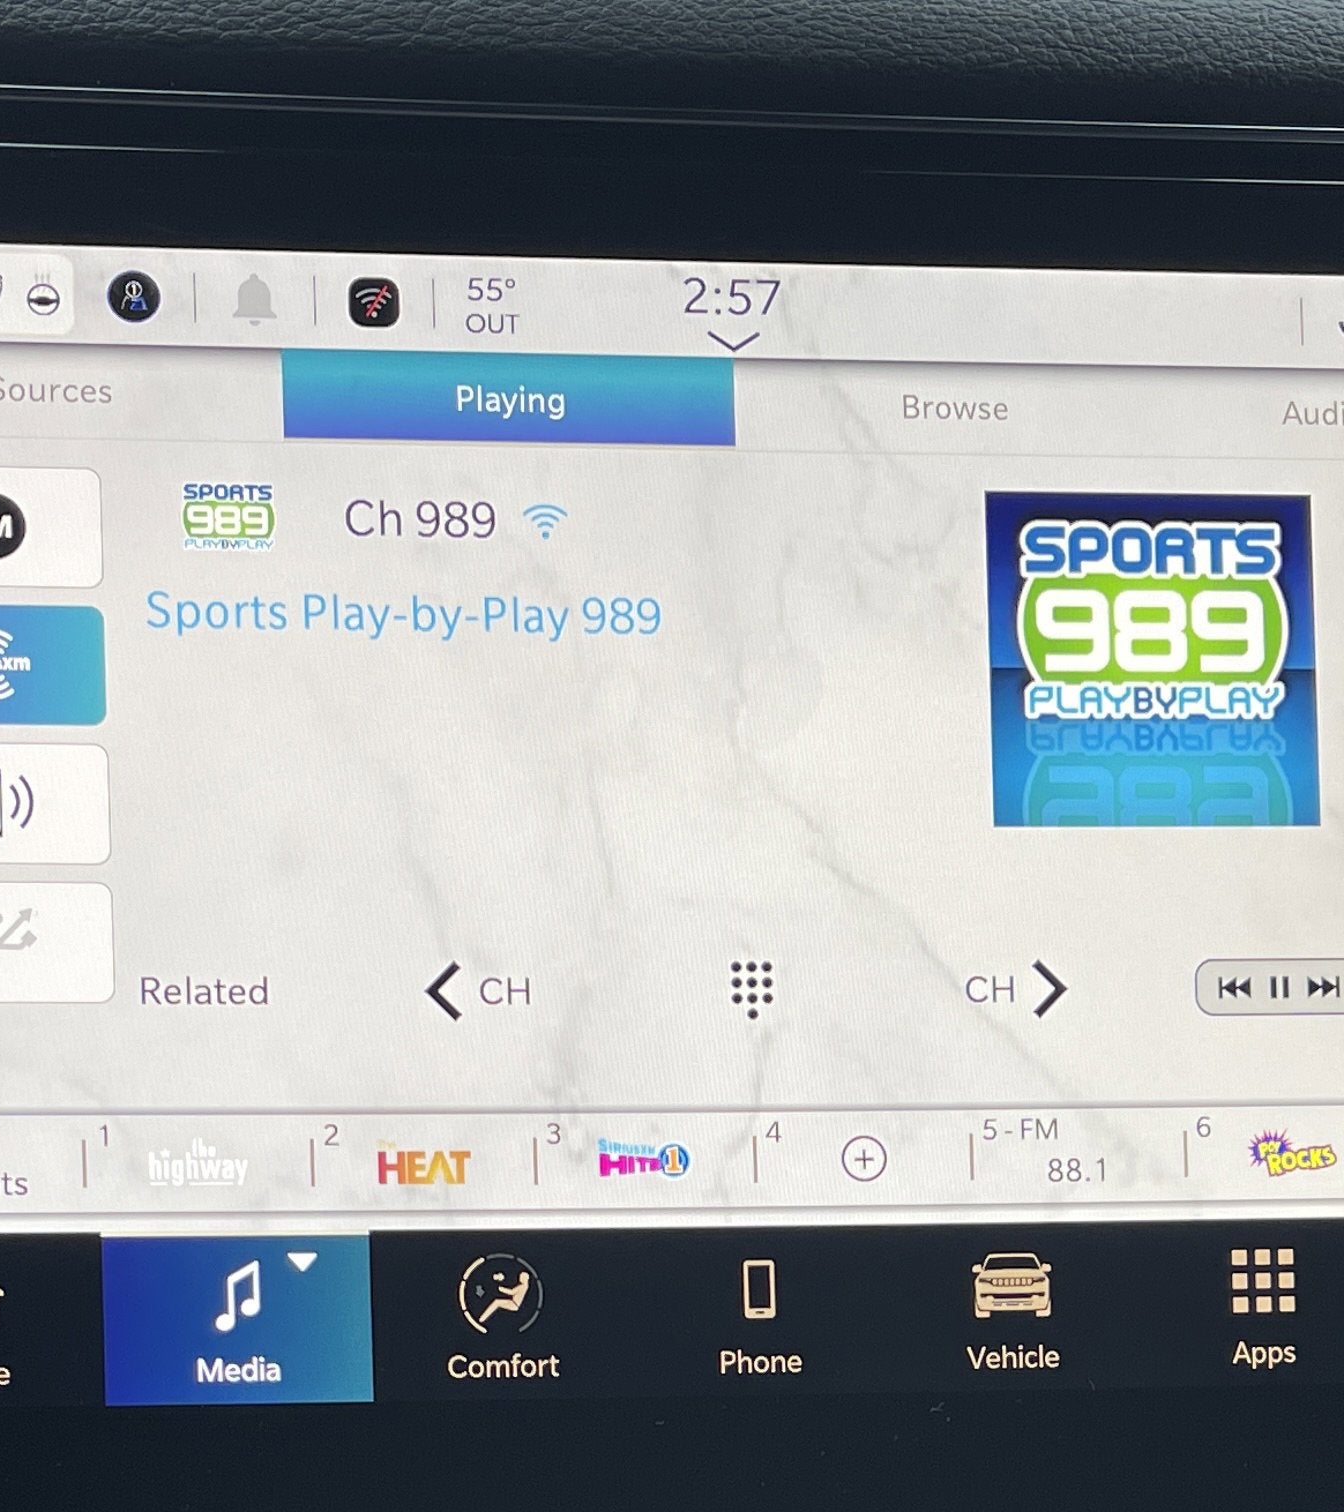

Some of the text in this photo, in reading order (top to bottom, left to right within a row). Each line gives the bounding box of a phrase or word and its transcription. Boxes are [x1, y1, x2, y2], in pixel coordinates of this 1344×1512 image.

[467, 276, 516, 302] 55°
[683, 278, 782, 318] 2:57
[465, 313, 520, 335] OUT
[456, 386, 566, 420] Playing
[902, 394, 1009, 423] Browse
[183, 483, 272, 501] SPORTS
[187, 505, 269, 536] 989
[346, 500, 497, 540] Ch 989
[1023, 525, 1278, 577] SPORTS
[146, 591, 663, 642] Sports Play-by-Play 989
[1034, 588, 1266, 675] 989
[139, 976, 270, 1008] Related
[478, 977, 531, 1007] CH
[965, 975, 1016, 1004] CH
[100, 1125, 109, 1147] 1
[324, 1124, 340, 1146] 2
[547, 1122, 561, 1145] 3
[766, 1121, 782, 1144] 4
[1196, 1117, 1212, 1139] 6
[148, 1151, 248, 1186] highway
[378, 1151, 471, 1184] HEAT
[1048, 1158, 1106, 1183] 88.1
[1266, 1146, 1337, 1176] ROCKS
[447, 1353, 560, 1379] Comfort
[720, 1349, 803, 1376] Phone
[967, 1345, 1060, 1371] Vehicle
[1232, 1342, 1297, 1369] Apps
[196, 1357, 282, 1383] Media
